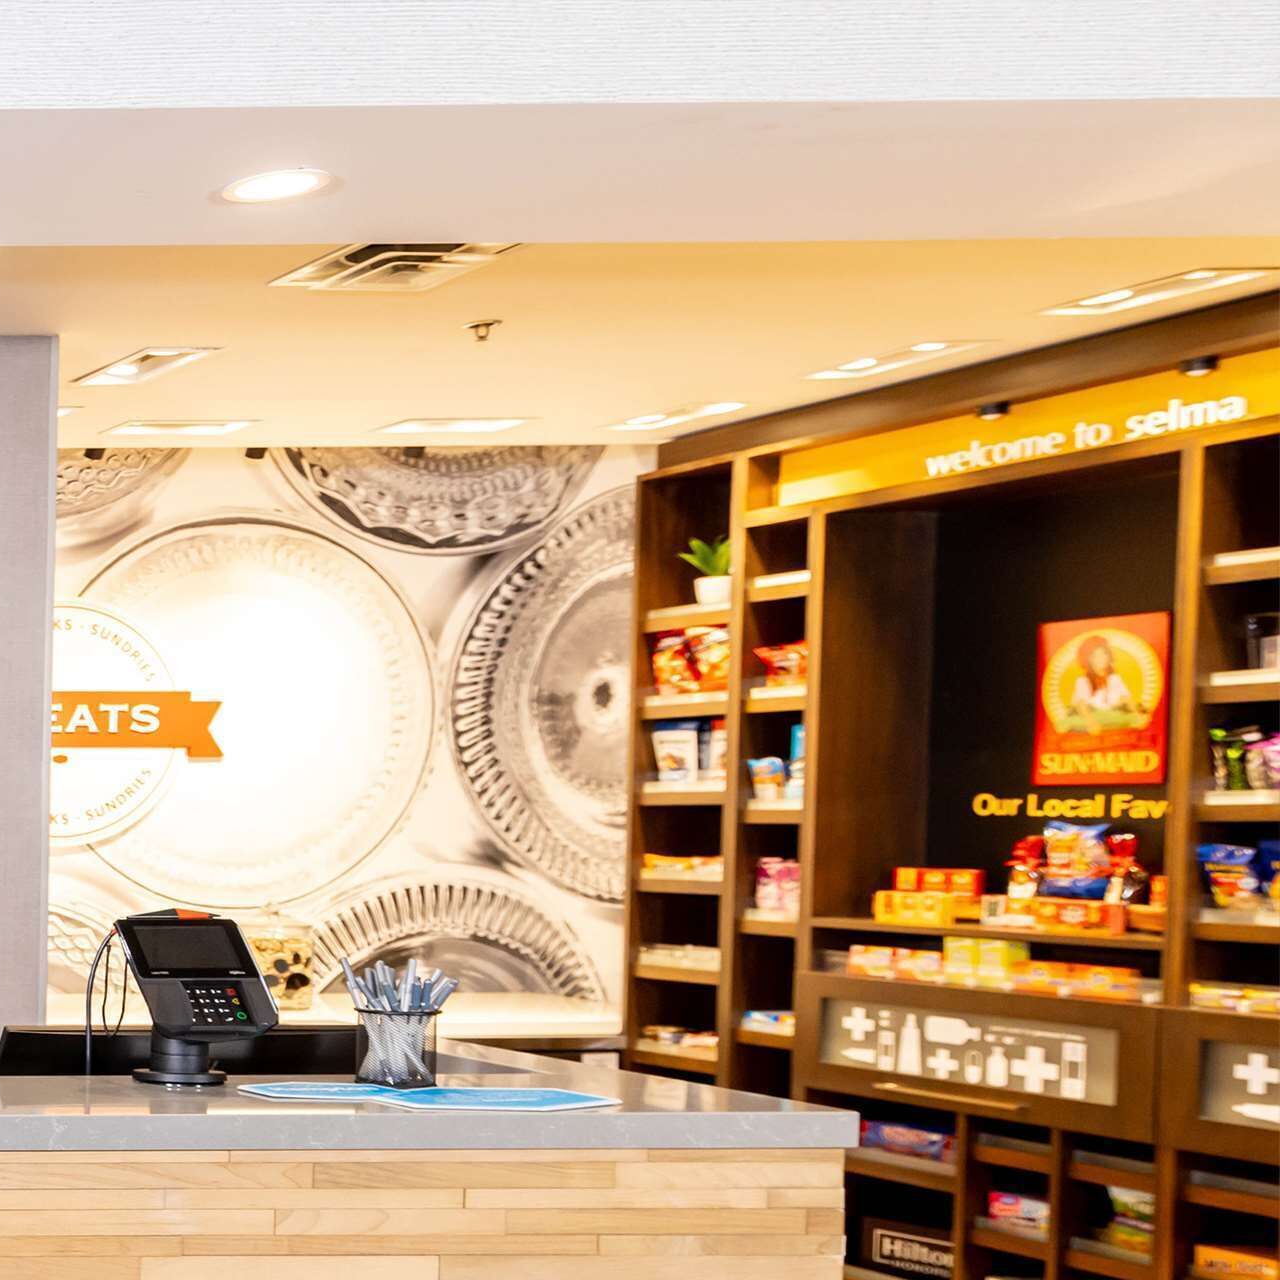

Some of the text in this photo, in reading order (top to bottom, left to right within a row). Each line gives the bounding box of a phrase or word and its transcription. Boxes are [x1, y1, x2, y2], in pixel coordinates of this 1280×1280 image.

[925, 393, 1248, 477] welcome to selma
[972, 793, 1169, 819] Our Local Fav
